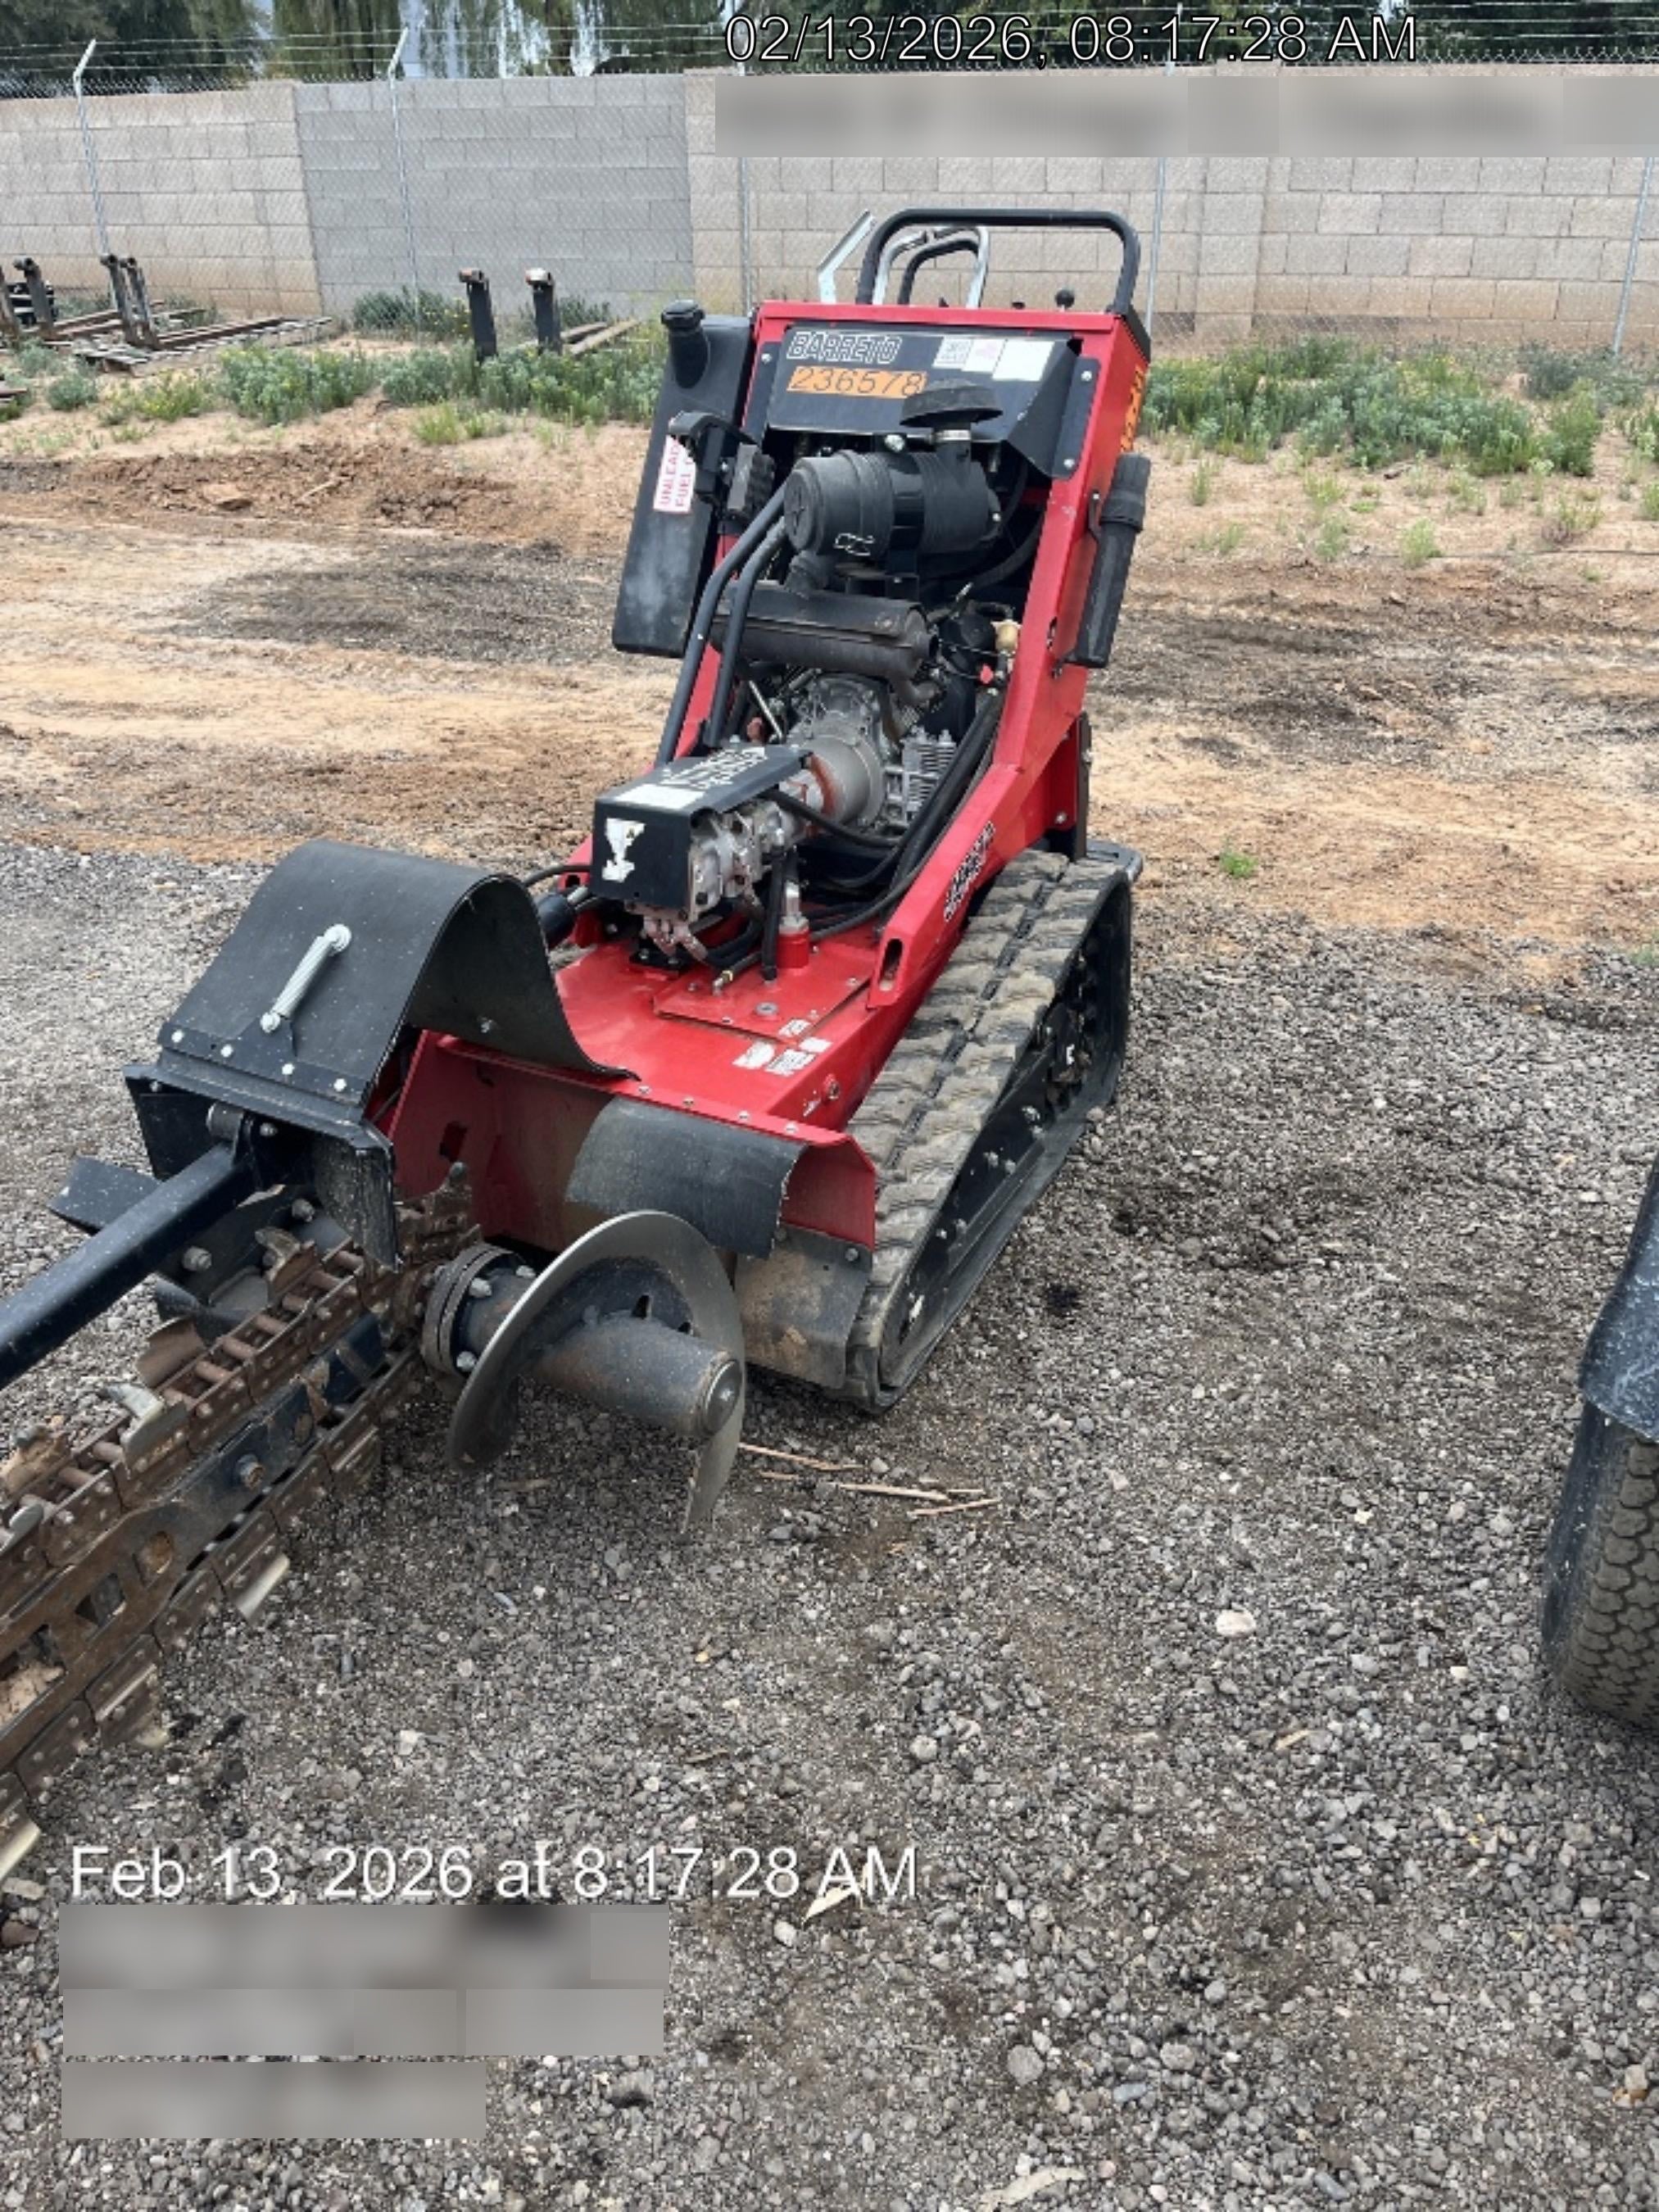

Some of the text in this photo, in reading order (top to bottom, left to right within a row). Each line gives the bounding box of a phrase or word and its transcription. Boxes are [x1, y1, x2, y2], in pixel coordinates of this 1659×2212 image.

[786, 331, 903, 365] BARRETO
[790, 368, 922, 397] 236578
[659, 439, 680, 505] UNLEAD
